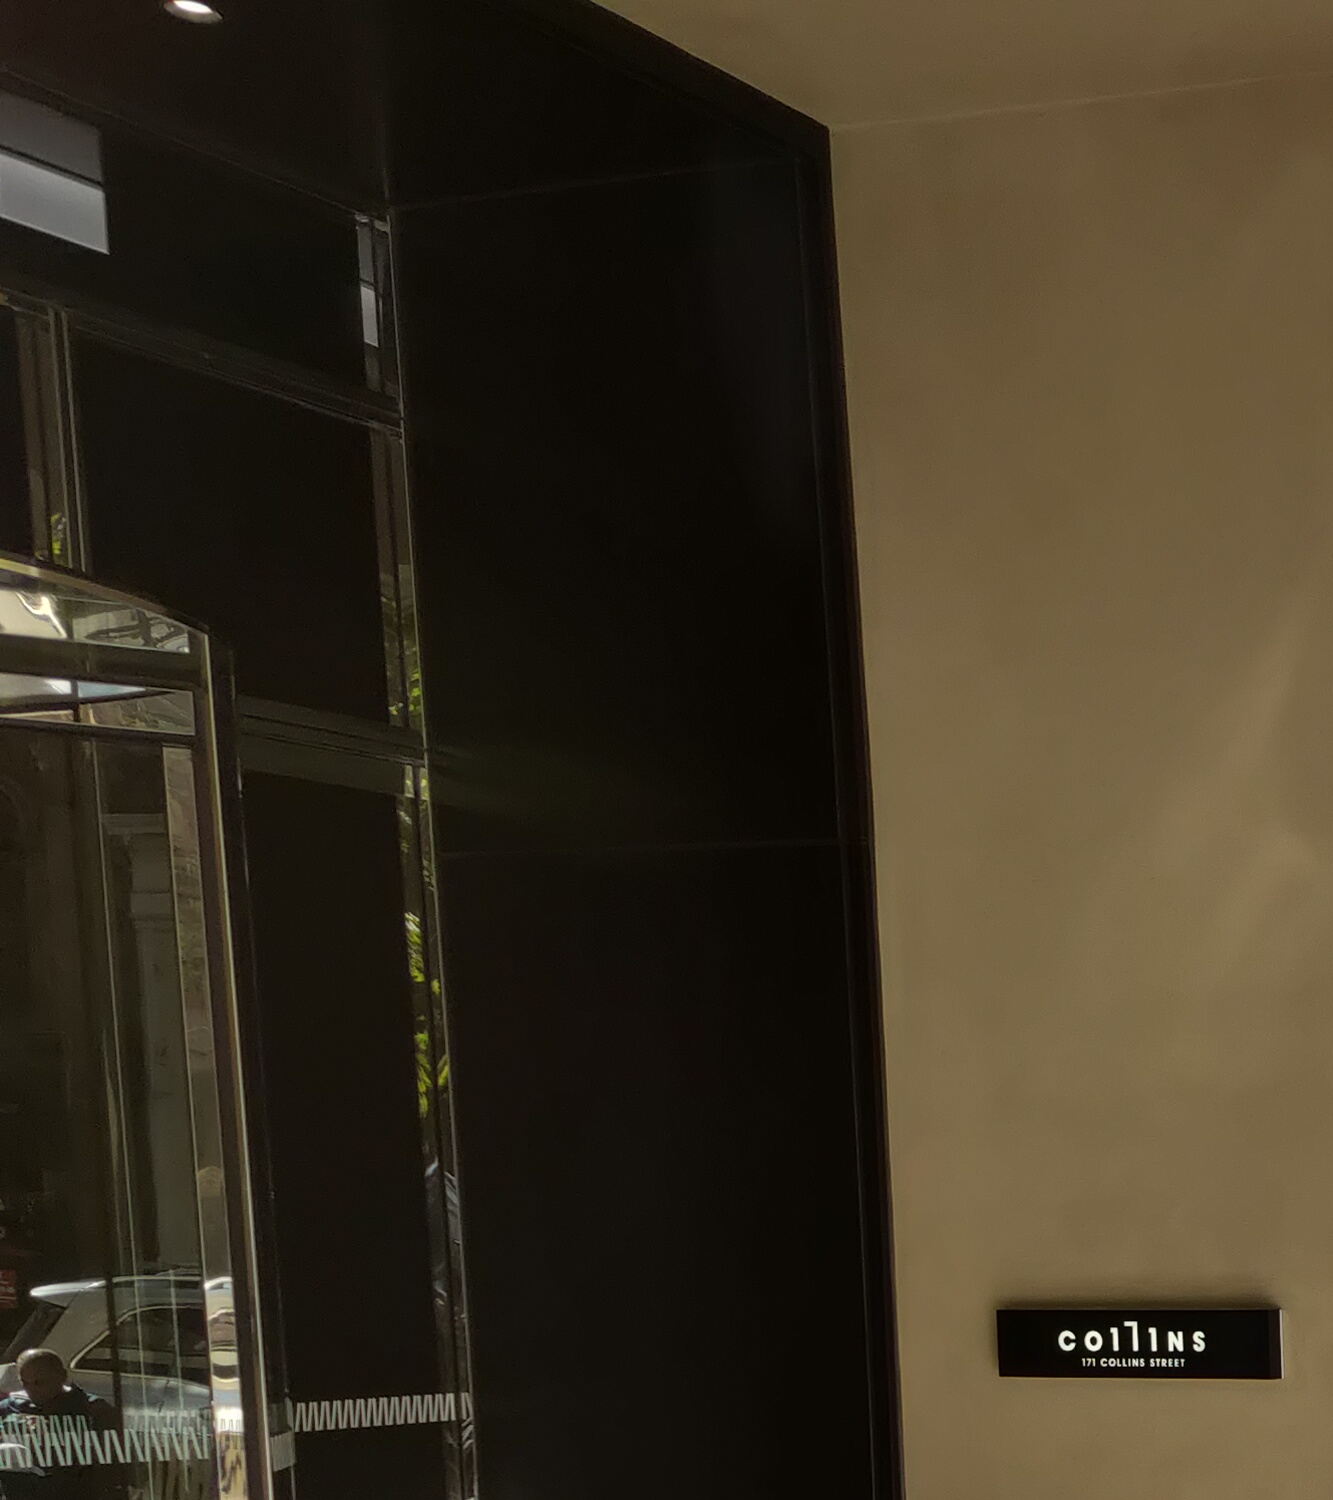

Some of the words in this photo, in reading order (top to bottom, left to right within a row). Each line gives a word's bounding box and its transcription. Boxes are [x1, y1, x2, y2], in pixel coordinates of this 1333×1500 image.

[1082, 1358, 1096, 1367] 171
[1100, 1358, 1145, 1367] COLLINS
[1150, 1358, 1185, 1367] STREET
